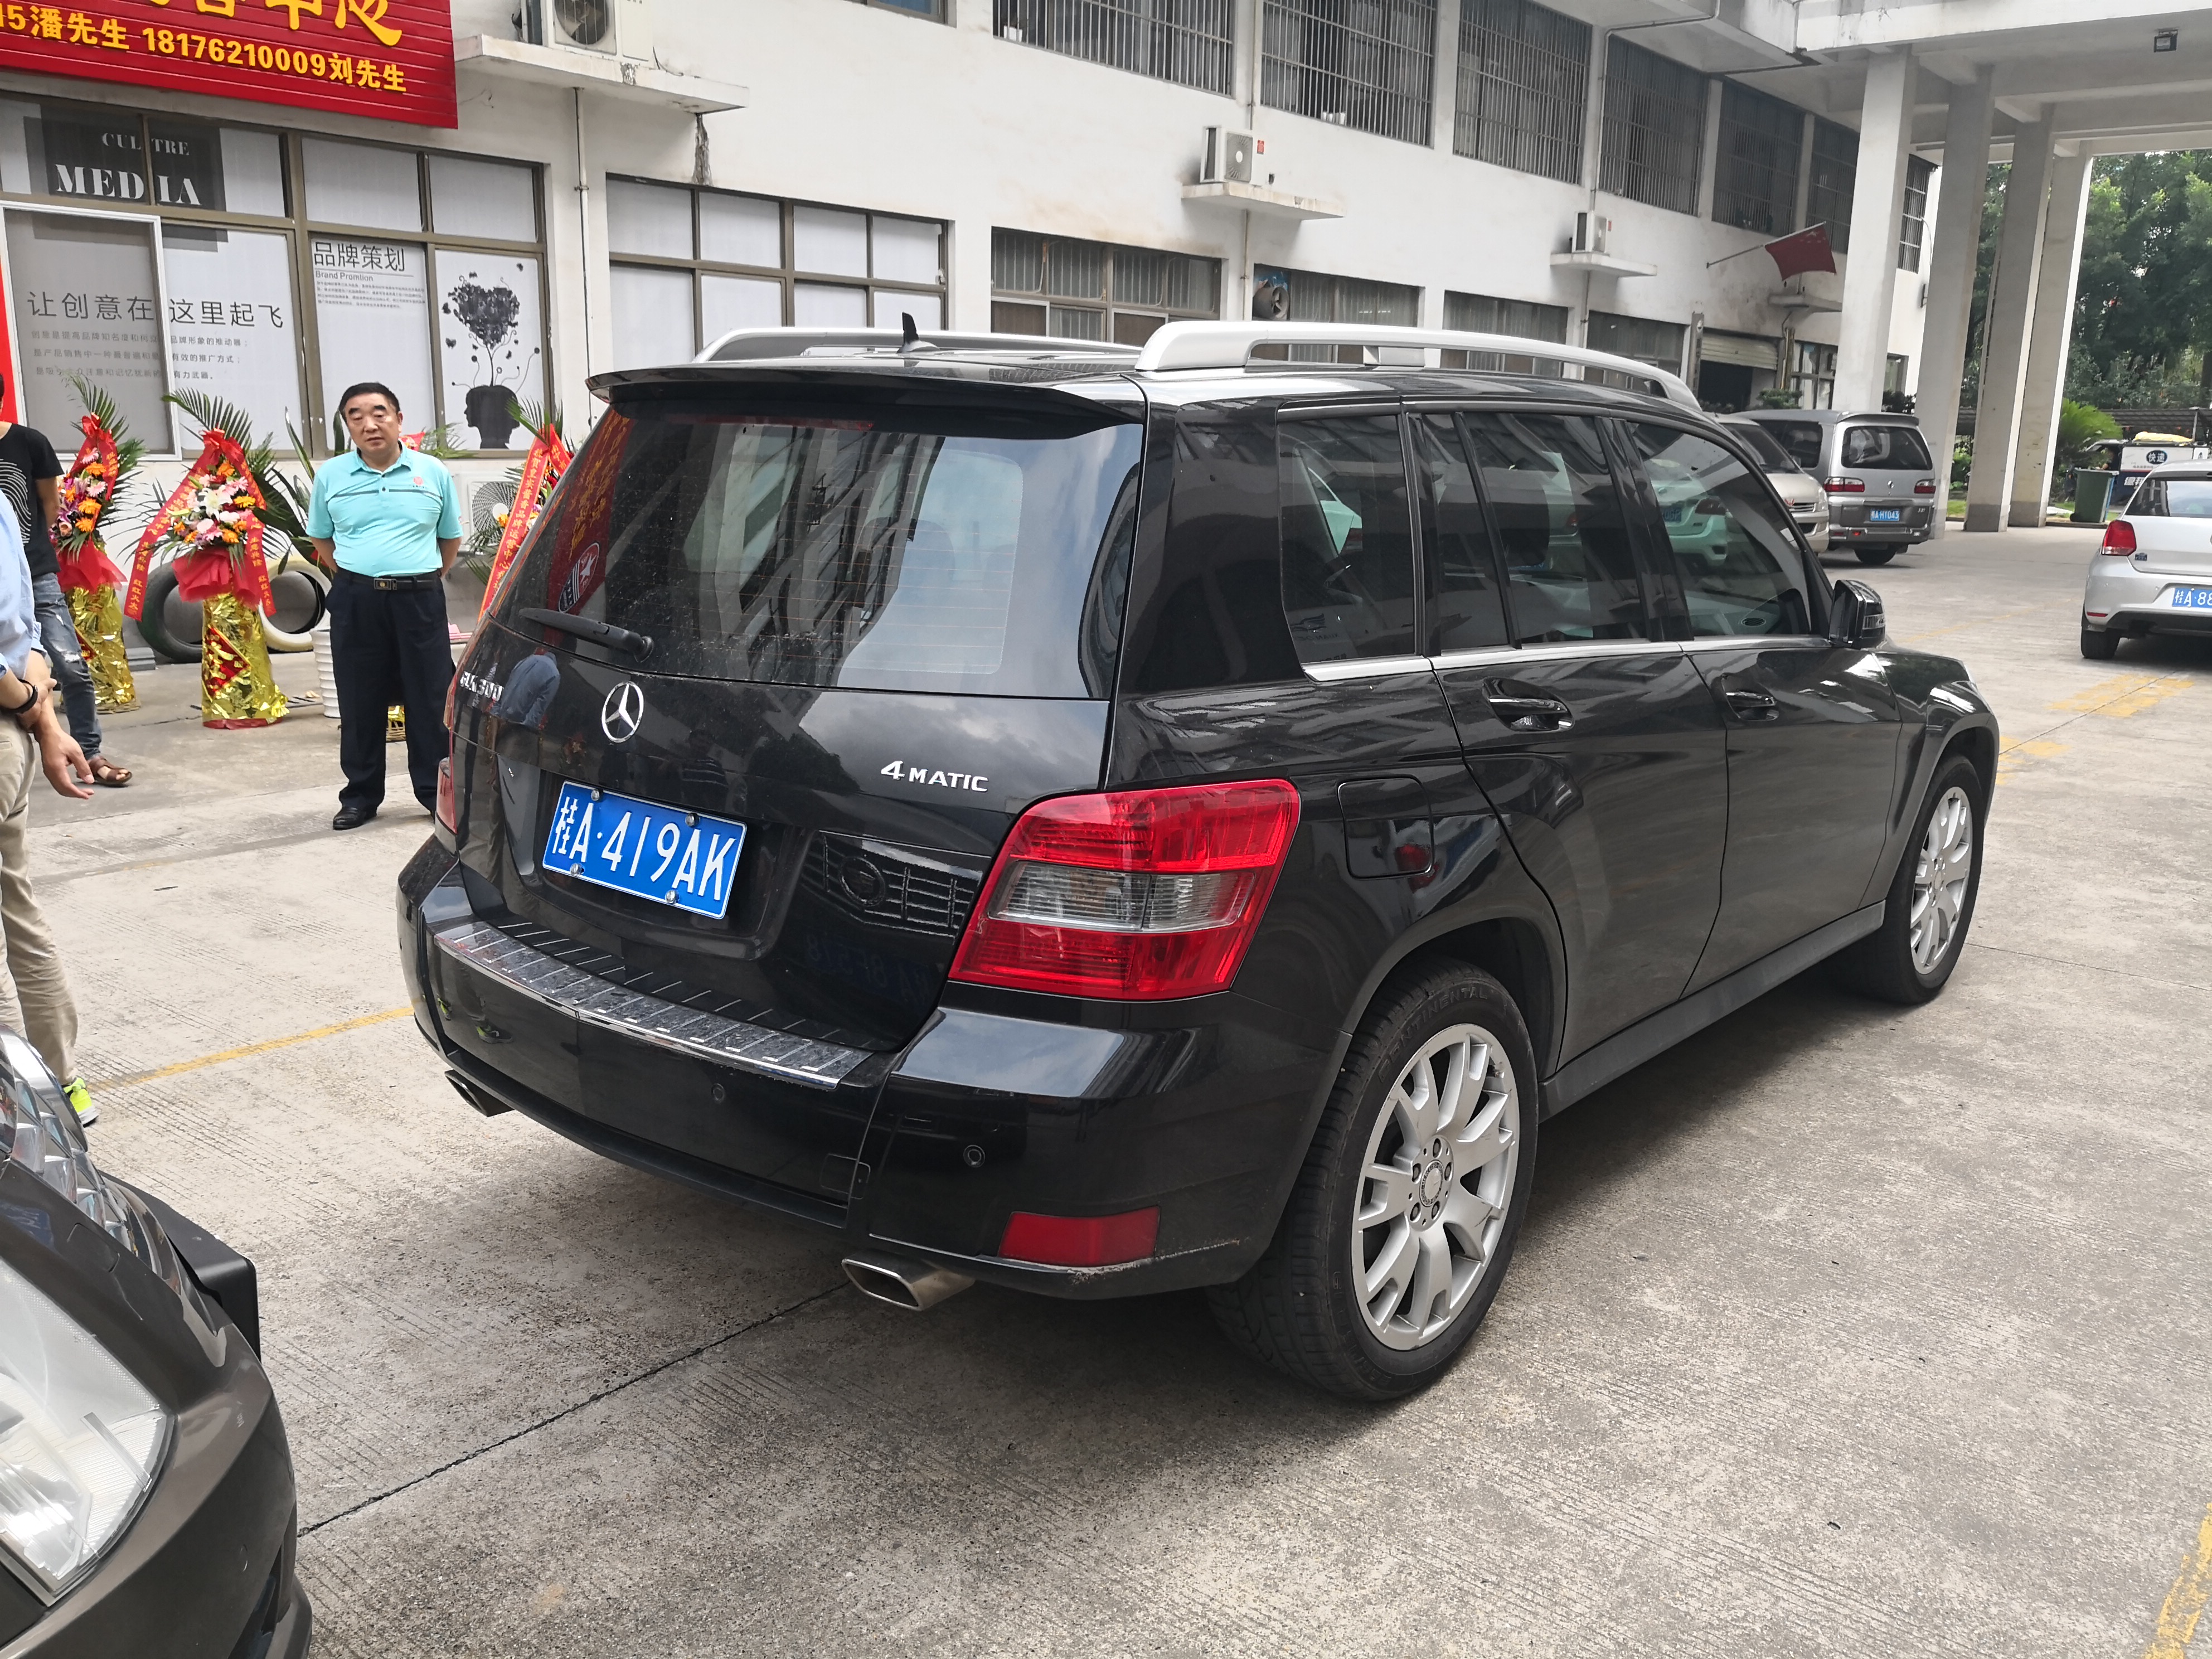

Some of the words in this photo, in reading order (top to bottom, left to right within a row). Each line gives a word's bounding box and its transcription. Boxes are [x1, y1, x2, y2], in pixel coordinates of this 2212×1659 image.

[142, 28, 406, 92] 18176210009刘先生
[314, 241, 405, 271] 品牌策划
[316, 270, 338, 279] Brand
[2148, 452, 2165, 463] 快递
[552, 796, 737, 901] 桂A·419AK
